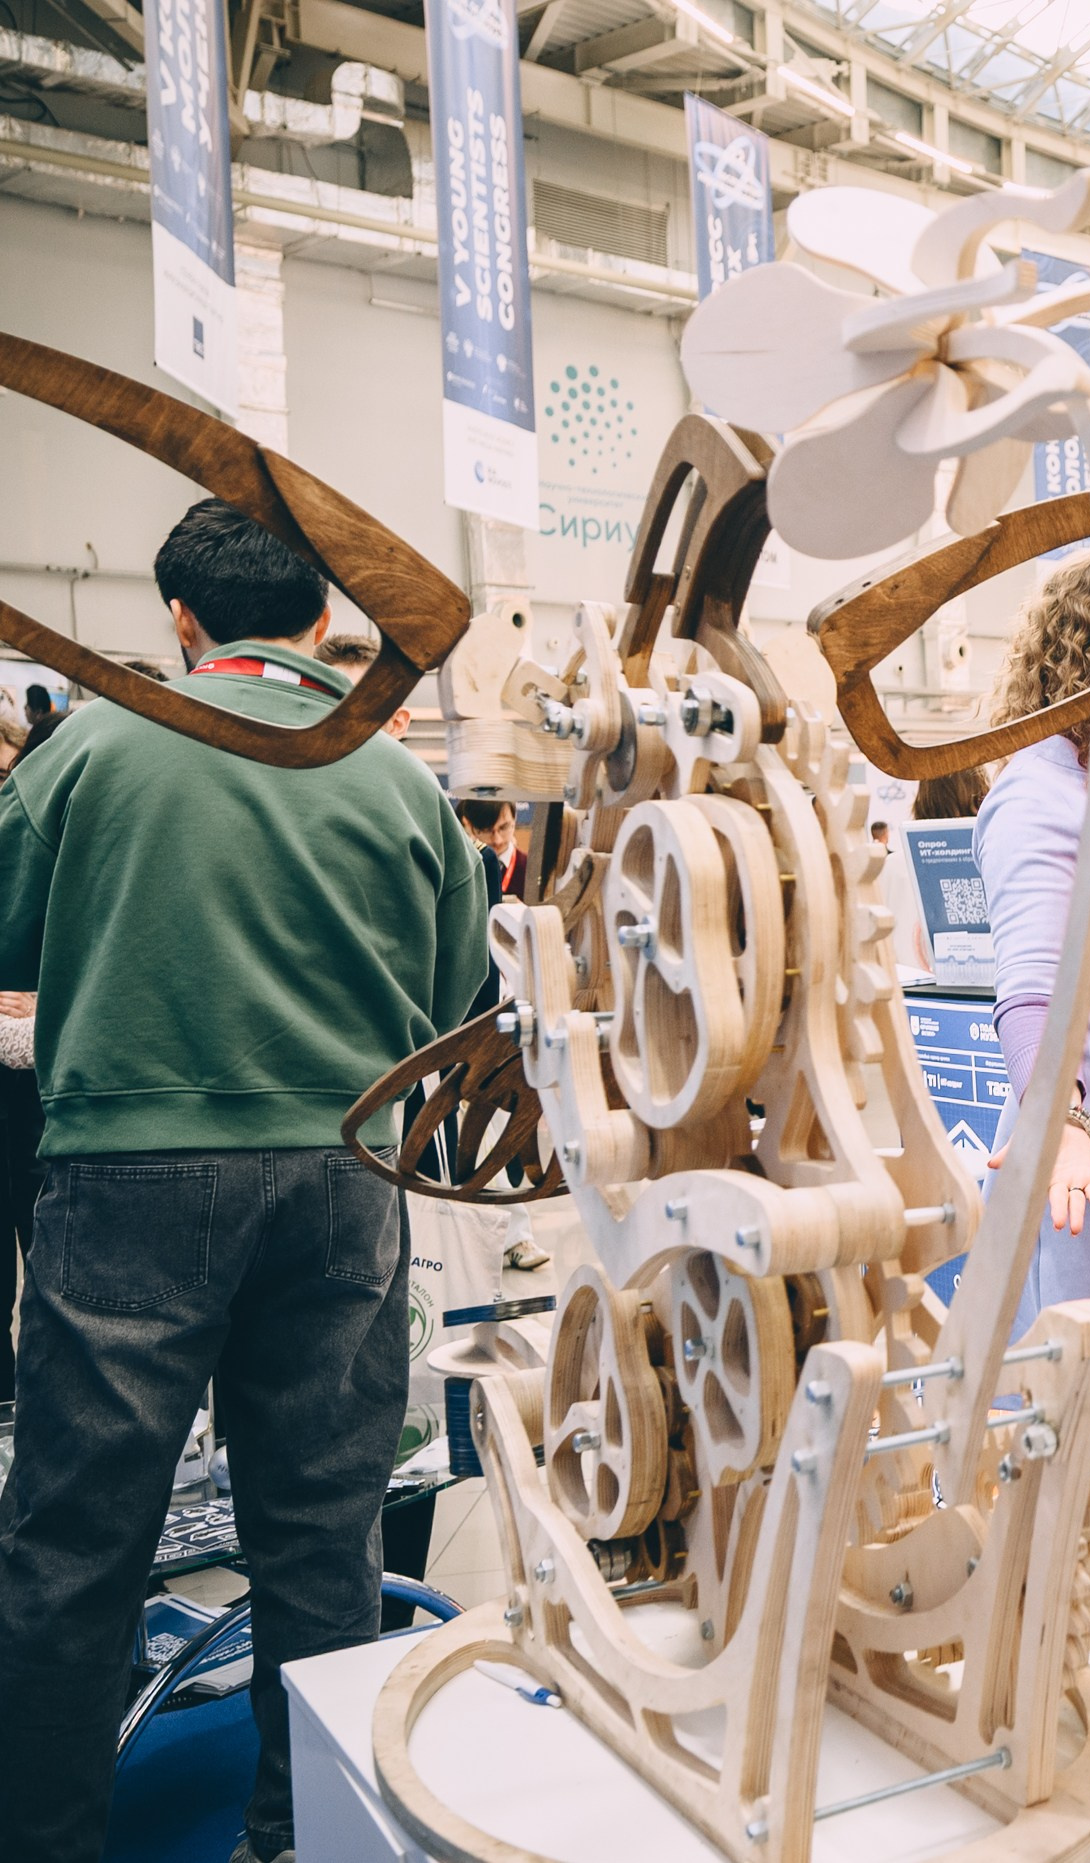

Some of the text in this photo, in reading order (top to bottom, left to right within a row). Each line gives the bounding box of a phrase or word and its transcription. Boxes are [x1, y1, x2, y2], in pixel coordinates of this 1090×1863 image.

[447, 115, 472, 307] V YOUNG
[467, 86, 493, 323] SCIENTISTS
[489, 112, 515, 331] CONGRESS
[917, 840, 948, 849] Опрос
[919, 848, 972, 857] ИТ-холдинг
[409, 1256, 443, 1272] АГРО
[409, 1279, 435, 1308] ТАЛОН
